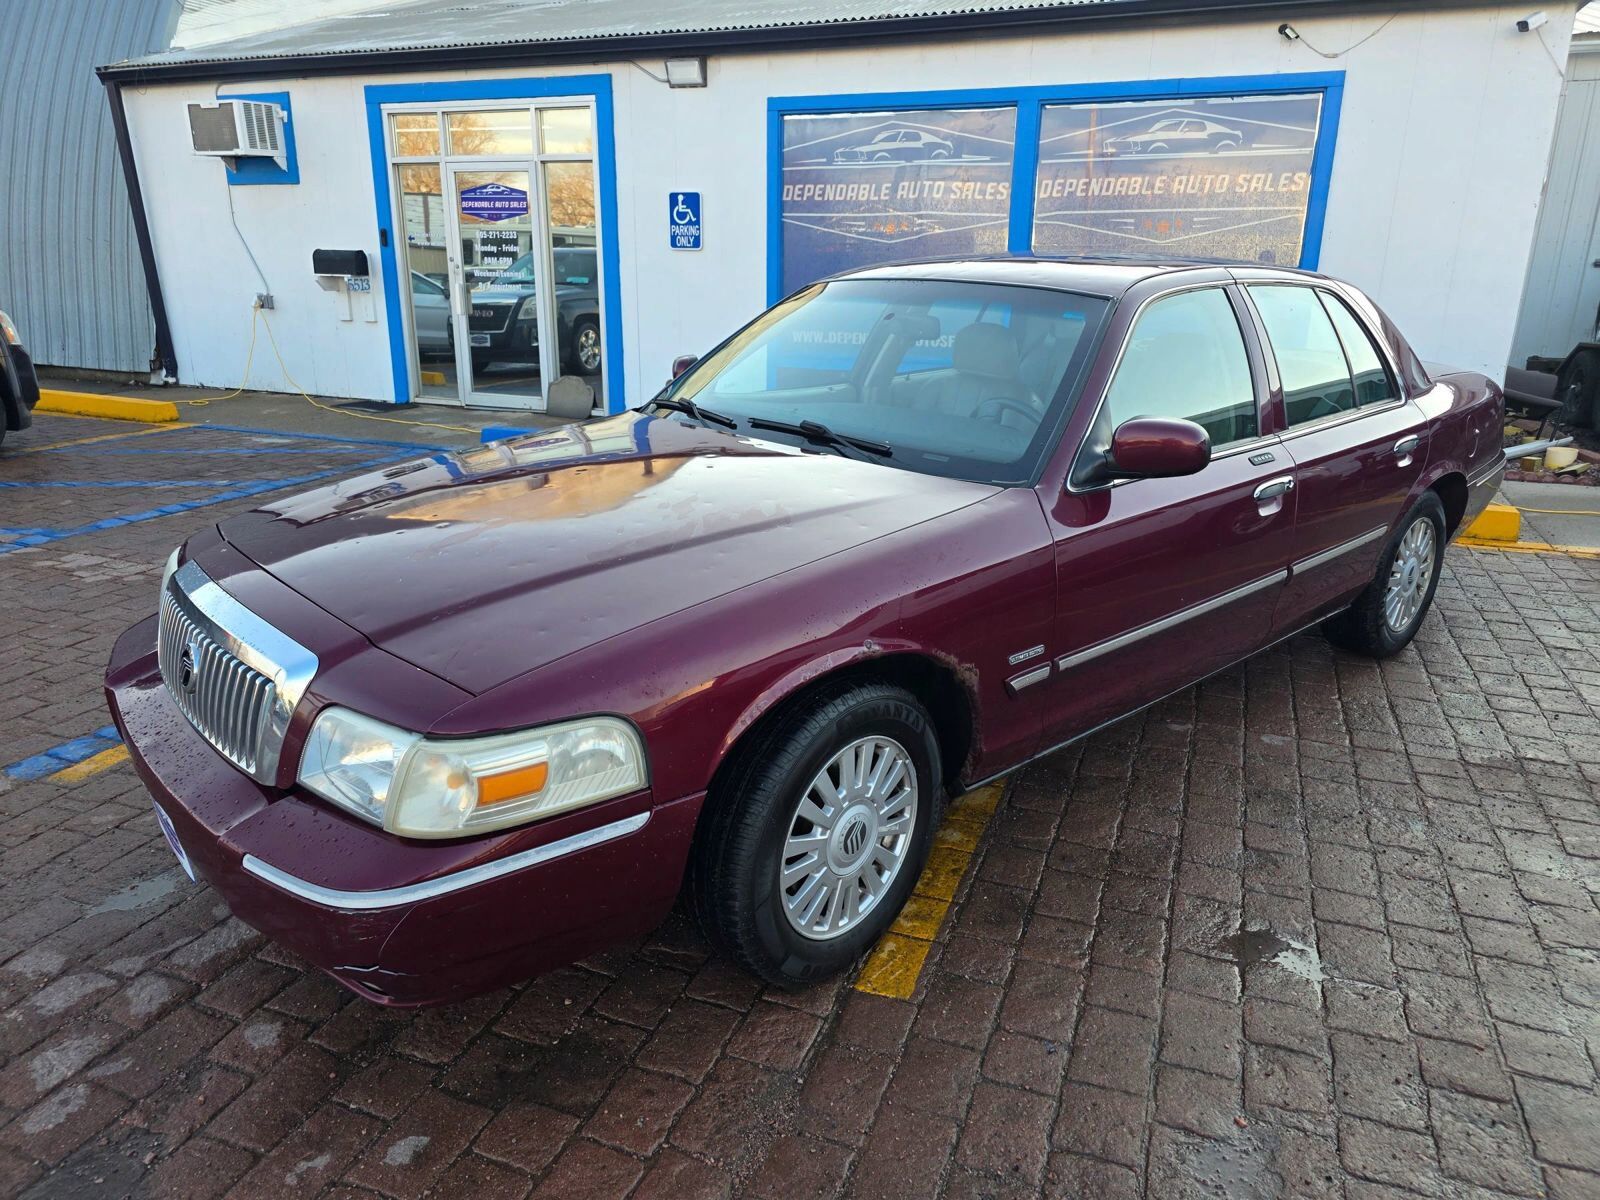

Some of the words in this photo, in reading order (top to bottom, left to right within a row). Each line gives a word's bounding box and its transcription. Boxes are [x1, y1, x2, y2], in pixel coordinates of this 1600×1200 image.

[782, 183, 891, 200] DEPENDABLE
[897, 181, 945, 199] AUTO
[950, 181, 1010, 200] SALES
[1040, 176, 1167, 199] DEPENDABLE
[1172, 174, 1229, 195] AUTO
[1235, 172, 1308, 193] SALES
[671, 225, 700, 236] PARKING
[676, 235, 695, 247] ONLY
[474, 243, 497, 253] Monday
[502, 243, 520, 253] Friday
[347, 278, 371, 291] 5513
